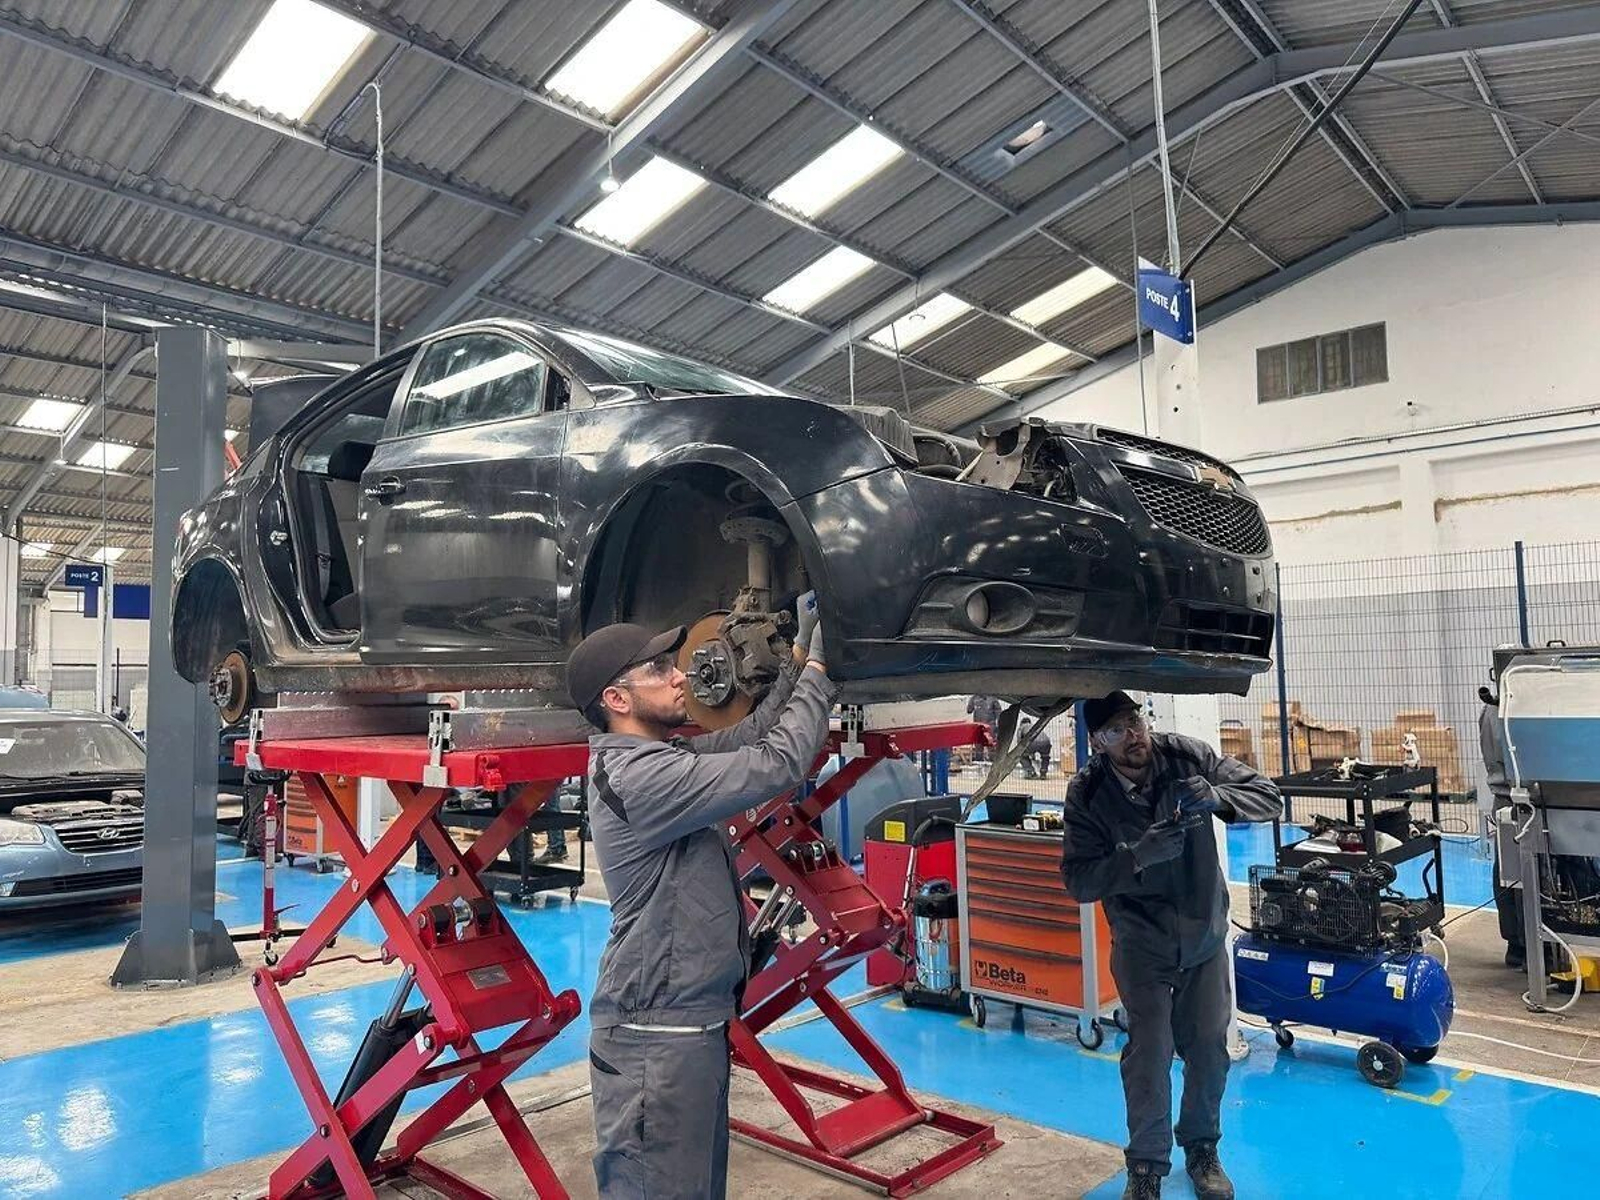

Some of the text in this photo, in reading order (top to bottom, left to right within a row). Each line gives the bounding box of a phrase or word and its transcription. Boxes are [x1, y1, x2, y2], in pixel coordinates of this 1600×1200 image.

[1146, 287, 1180, 323] POSTE 4
[90, 571, 99, 582] 2
[989, 963, 1026, 985] Beta
